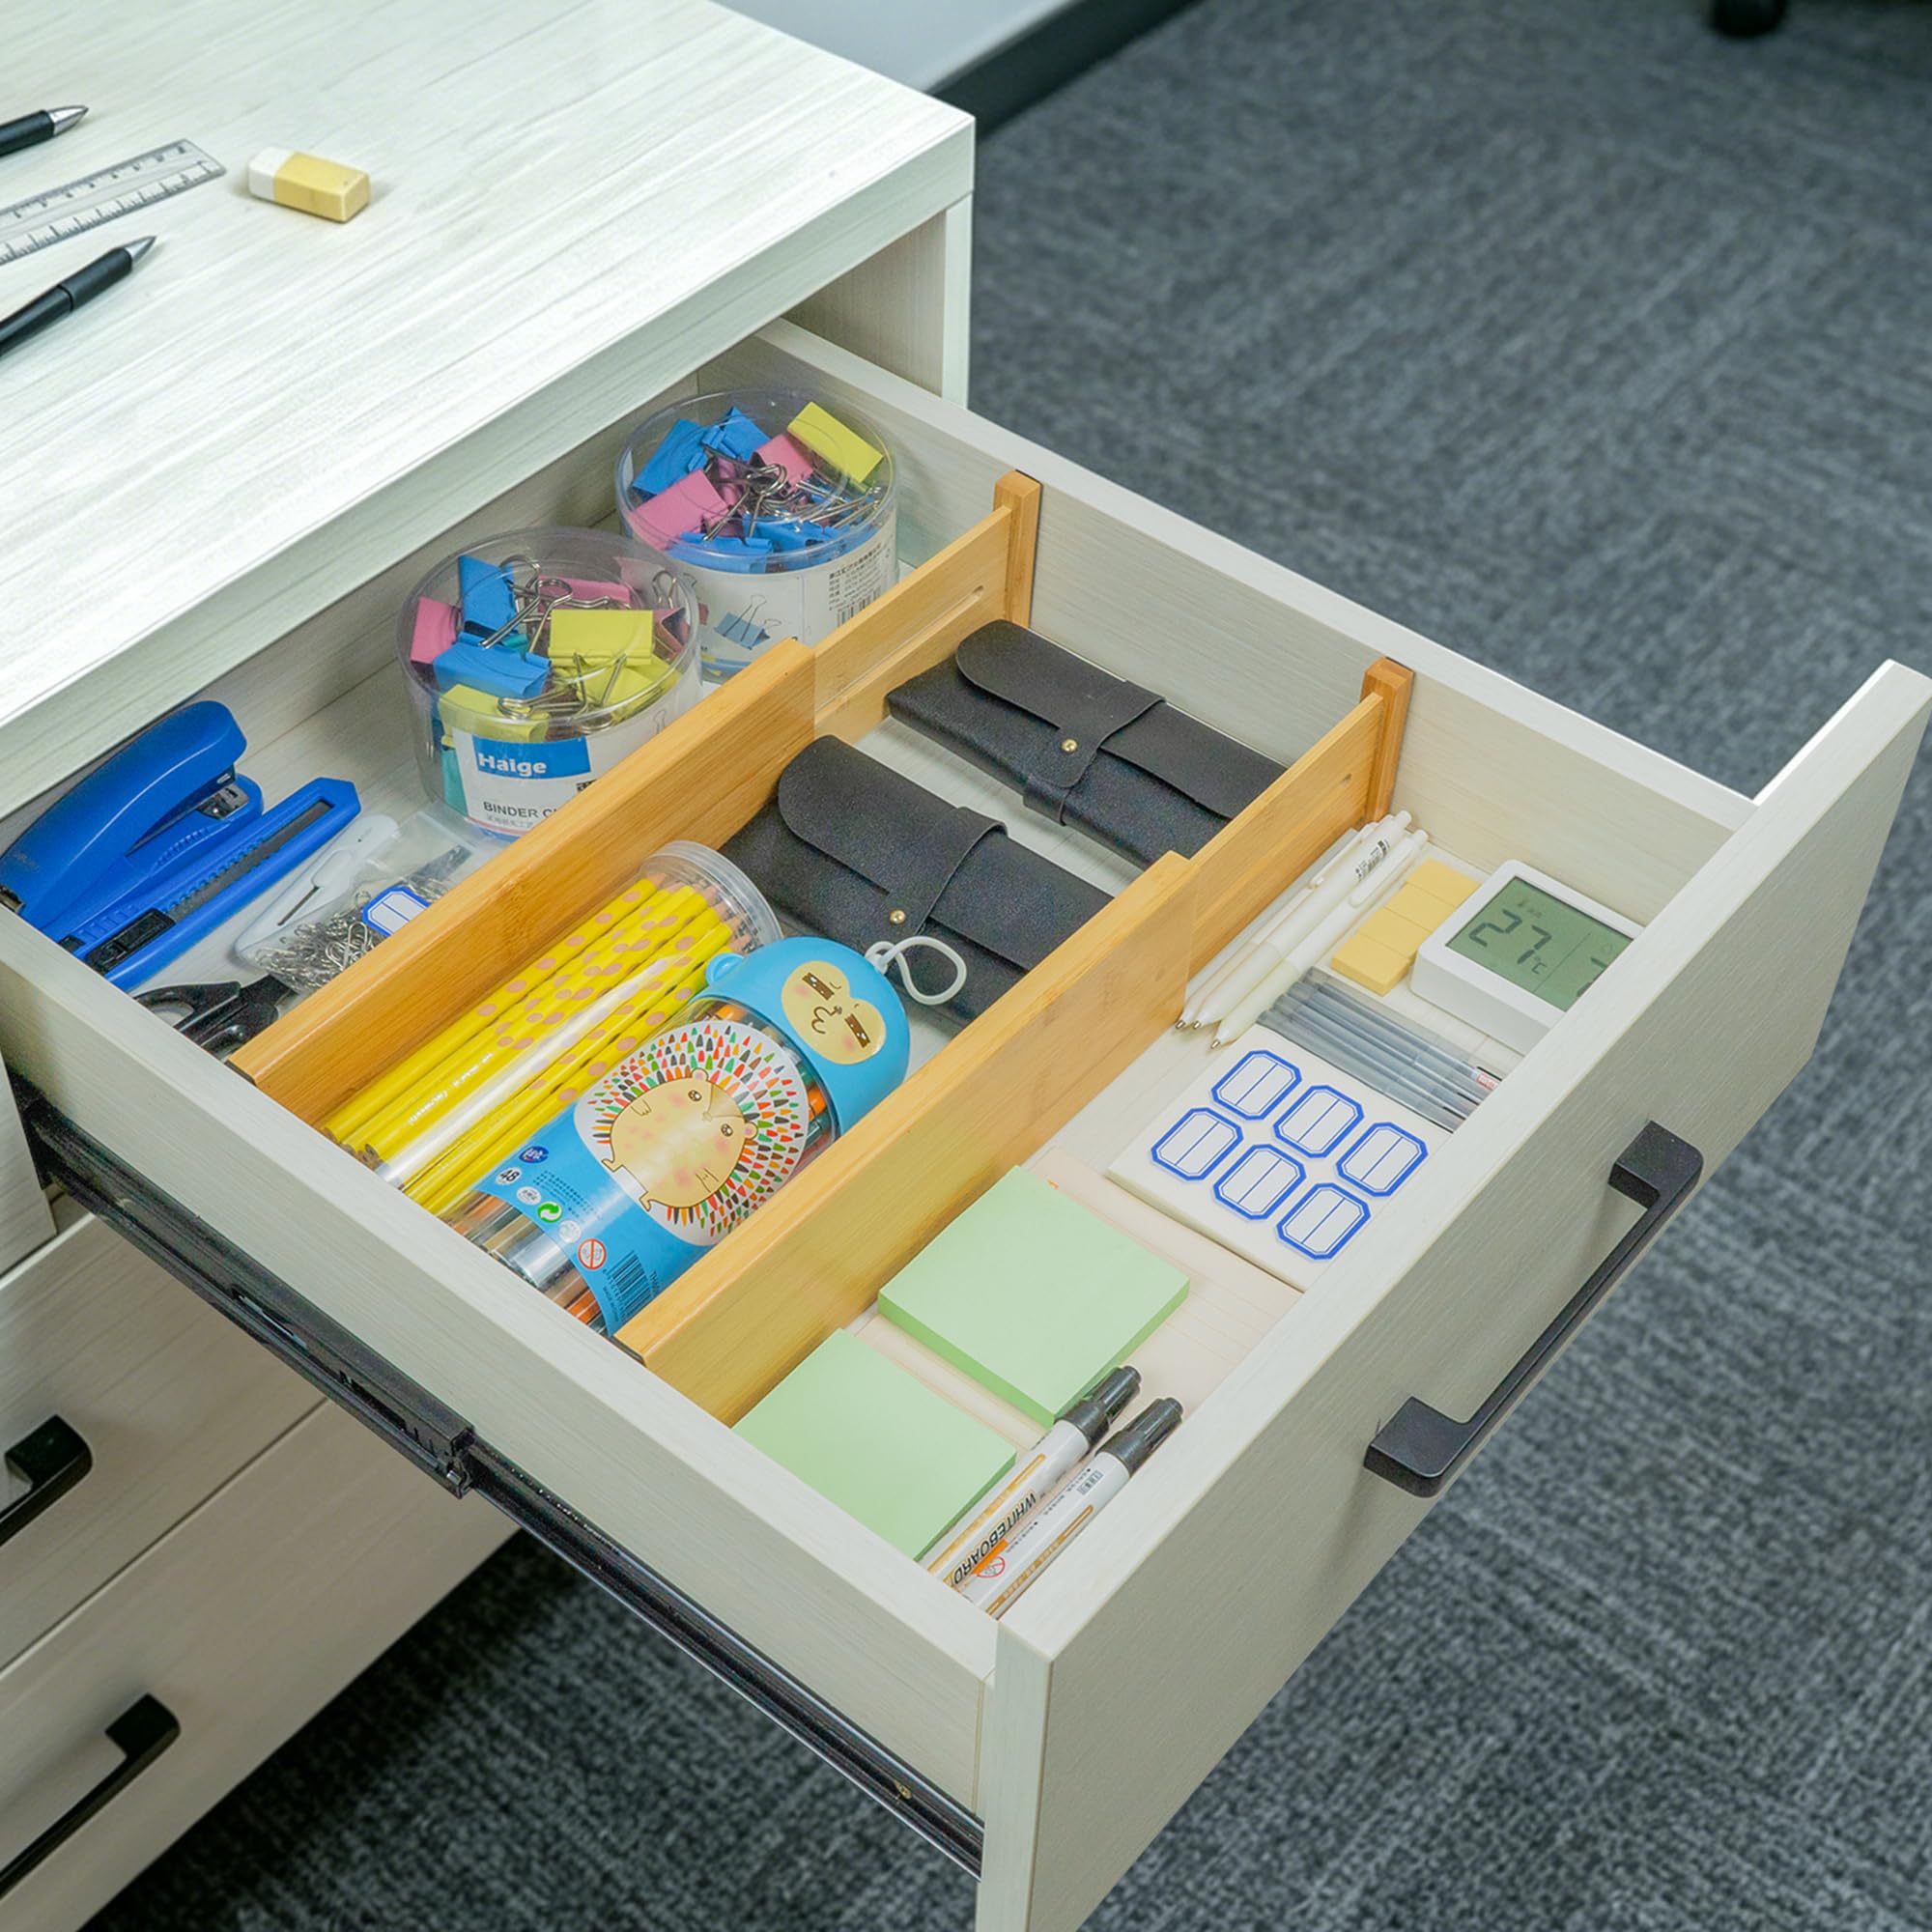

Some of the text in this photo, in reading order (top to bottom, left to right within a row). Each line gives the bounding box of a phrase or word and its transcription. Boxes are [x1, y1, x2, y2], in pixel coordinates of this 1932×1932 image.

[478, 753, 547, 777] Haige
[483, 802, 538, 818] BINDER
[1469, 909, 1551, 964] 27
[500, 1170, 520, 1181] 48
[953, 1492, 1037, 1584] WHITEBOARD
